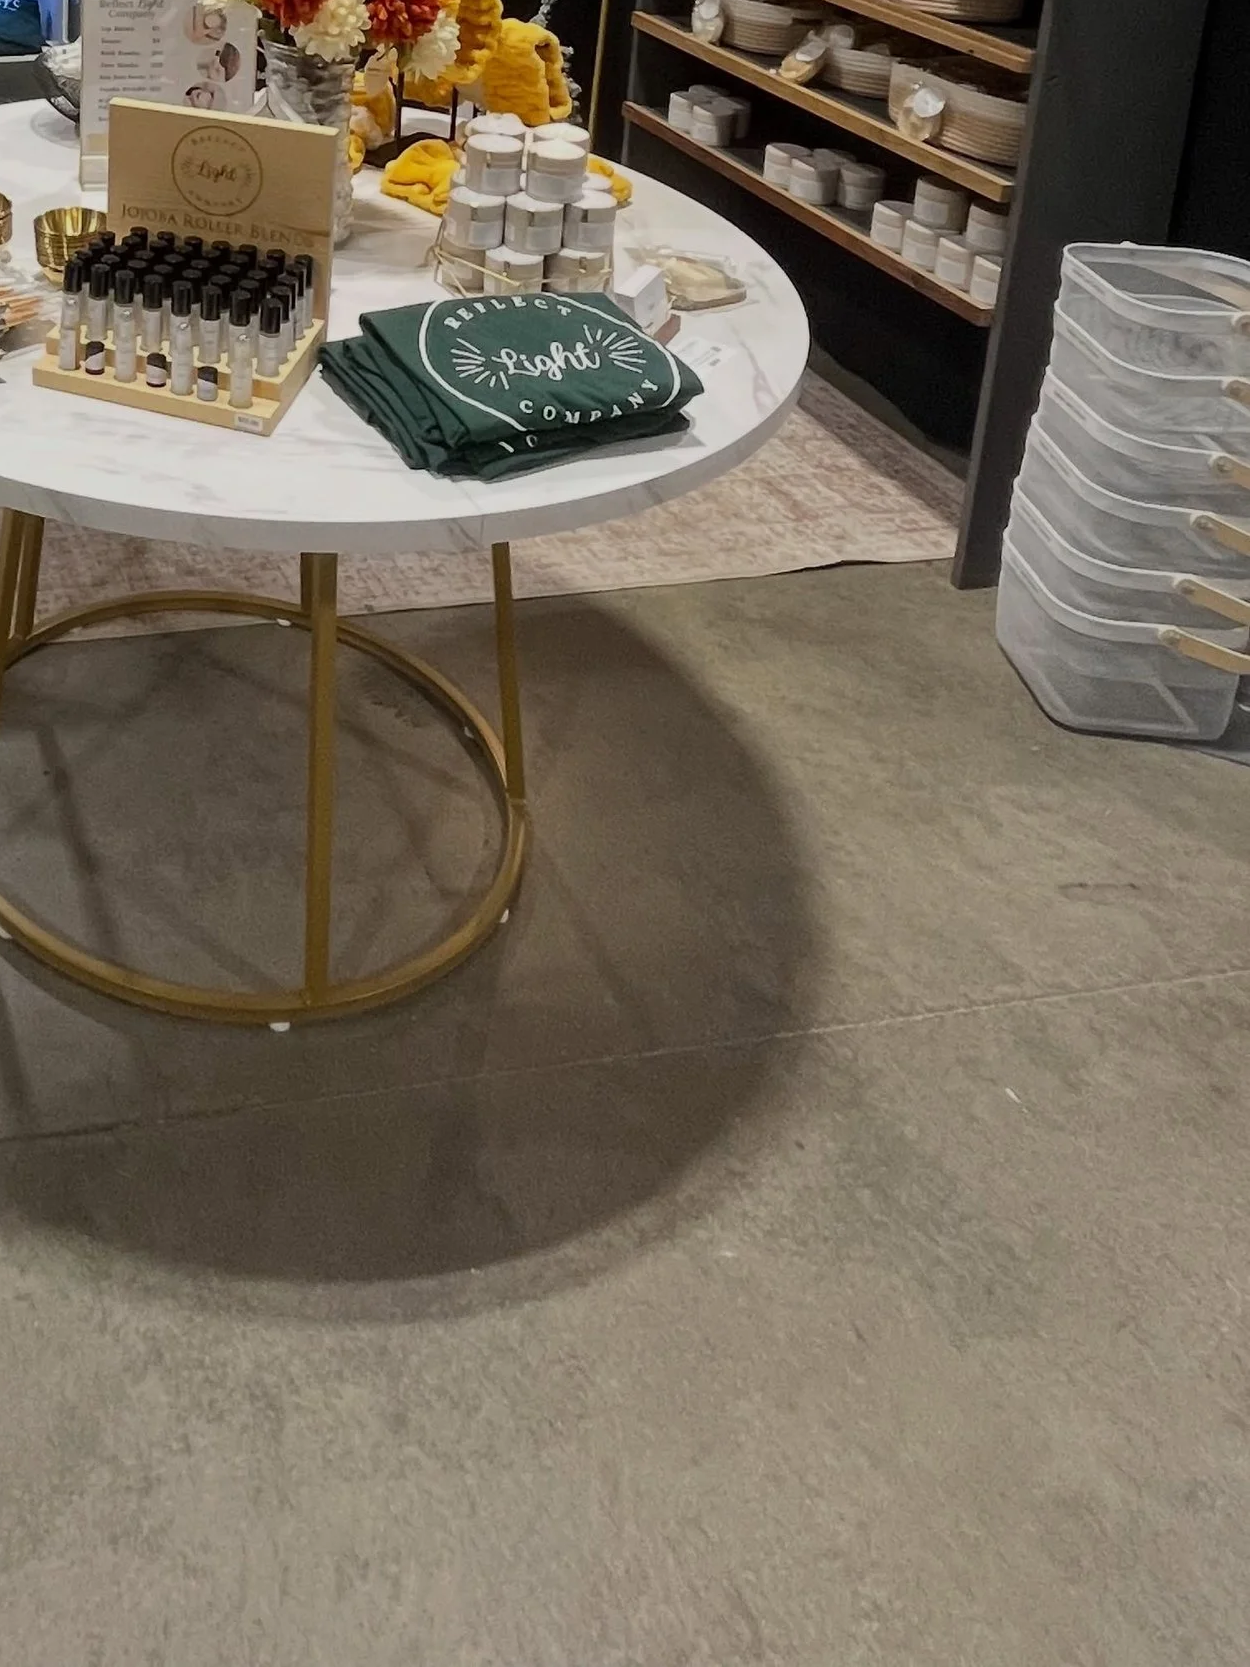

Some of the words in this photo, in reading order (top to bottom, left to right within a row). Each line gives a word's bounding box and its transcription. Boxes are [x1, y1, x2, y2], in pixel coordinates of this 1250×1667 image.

[196, 160, 237, 183] Light
[121, 203, 179, 226] JOJOBA
[183, 212, 246, 236] ROLLER
[443, 295, 572, 330] REFLECT
[491, 341, 601, 381] Light
[518, 378, 659, 425] COMPANY
